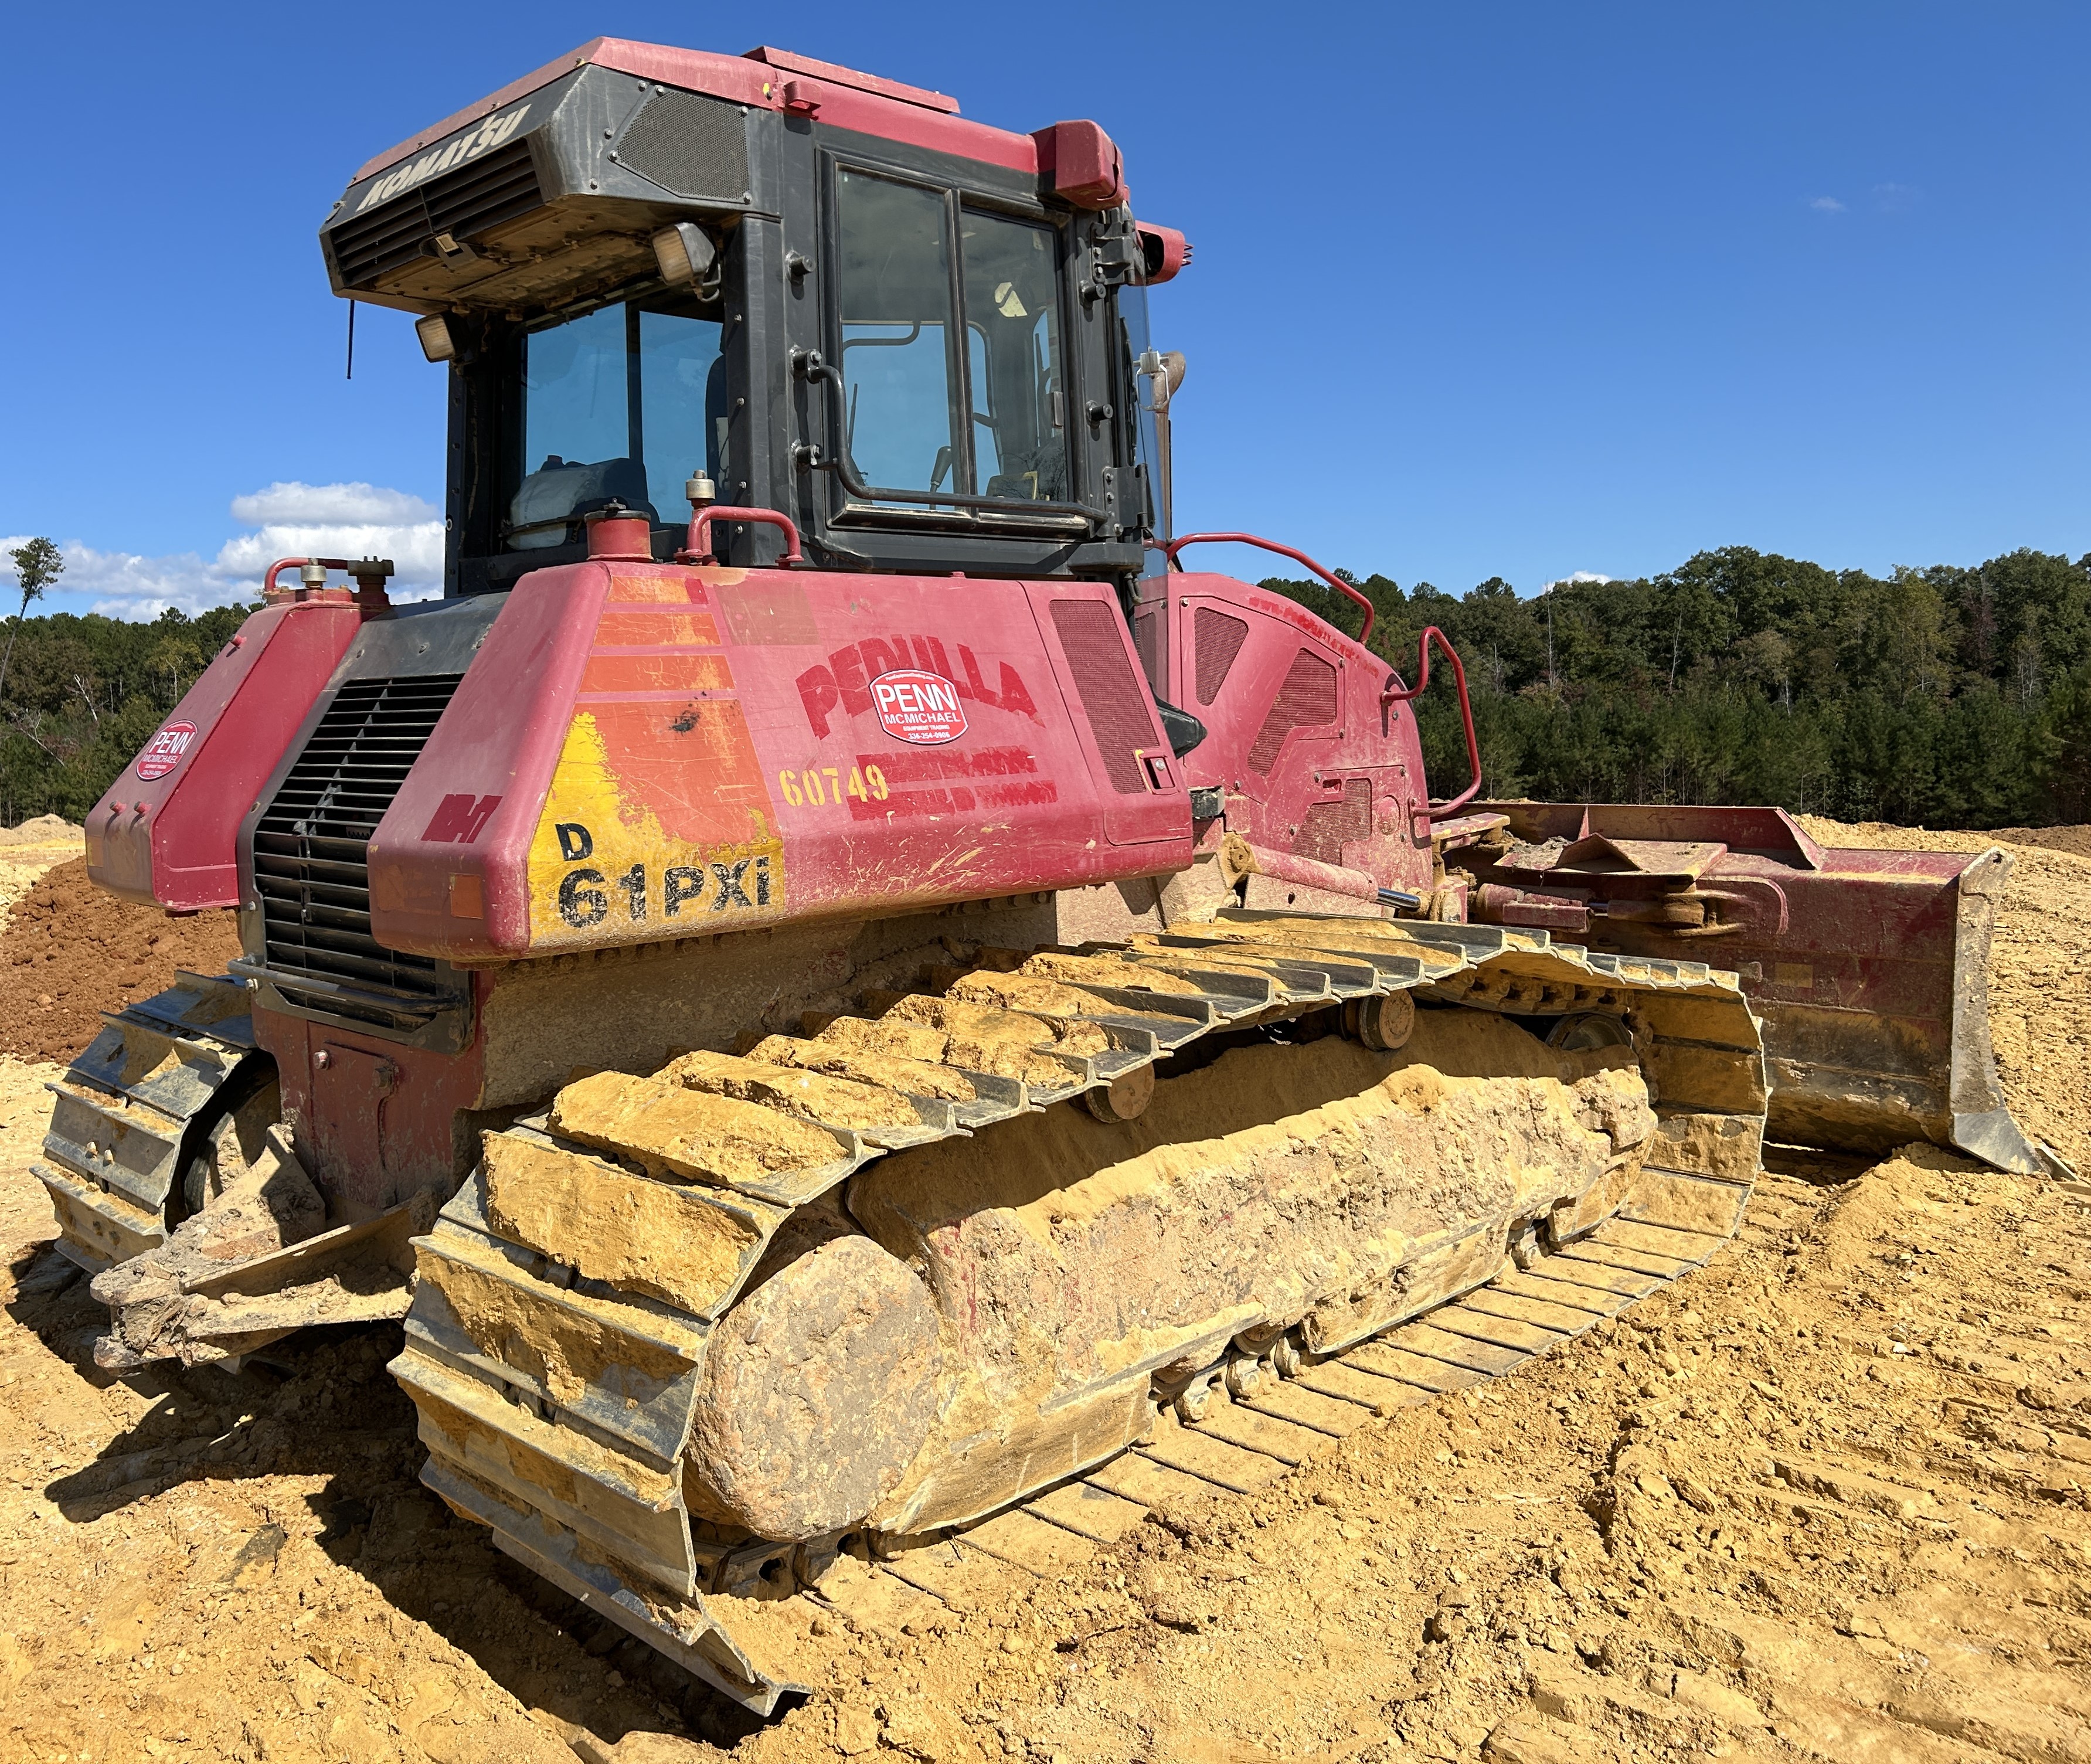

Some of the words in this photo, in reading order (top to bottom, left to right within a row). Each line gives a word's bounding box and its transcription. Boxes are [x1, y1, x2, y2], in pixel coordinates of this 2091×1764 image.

[356, 104, 532, 212] KOMATSU
[875, 684, 957, 712] PENN
[884, 712, 961, 724] MCMICHAEL
[142, 754, 178, 764] MCMICHAEL
[148, 732, 195, 754] PENN
[779, 764, 889, 807] 60749
[555, 822, 593, 861] D
[559, 856, 770, 928] 61PXi
